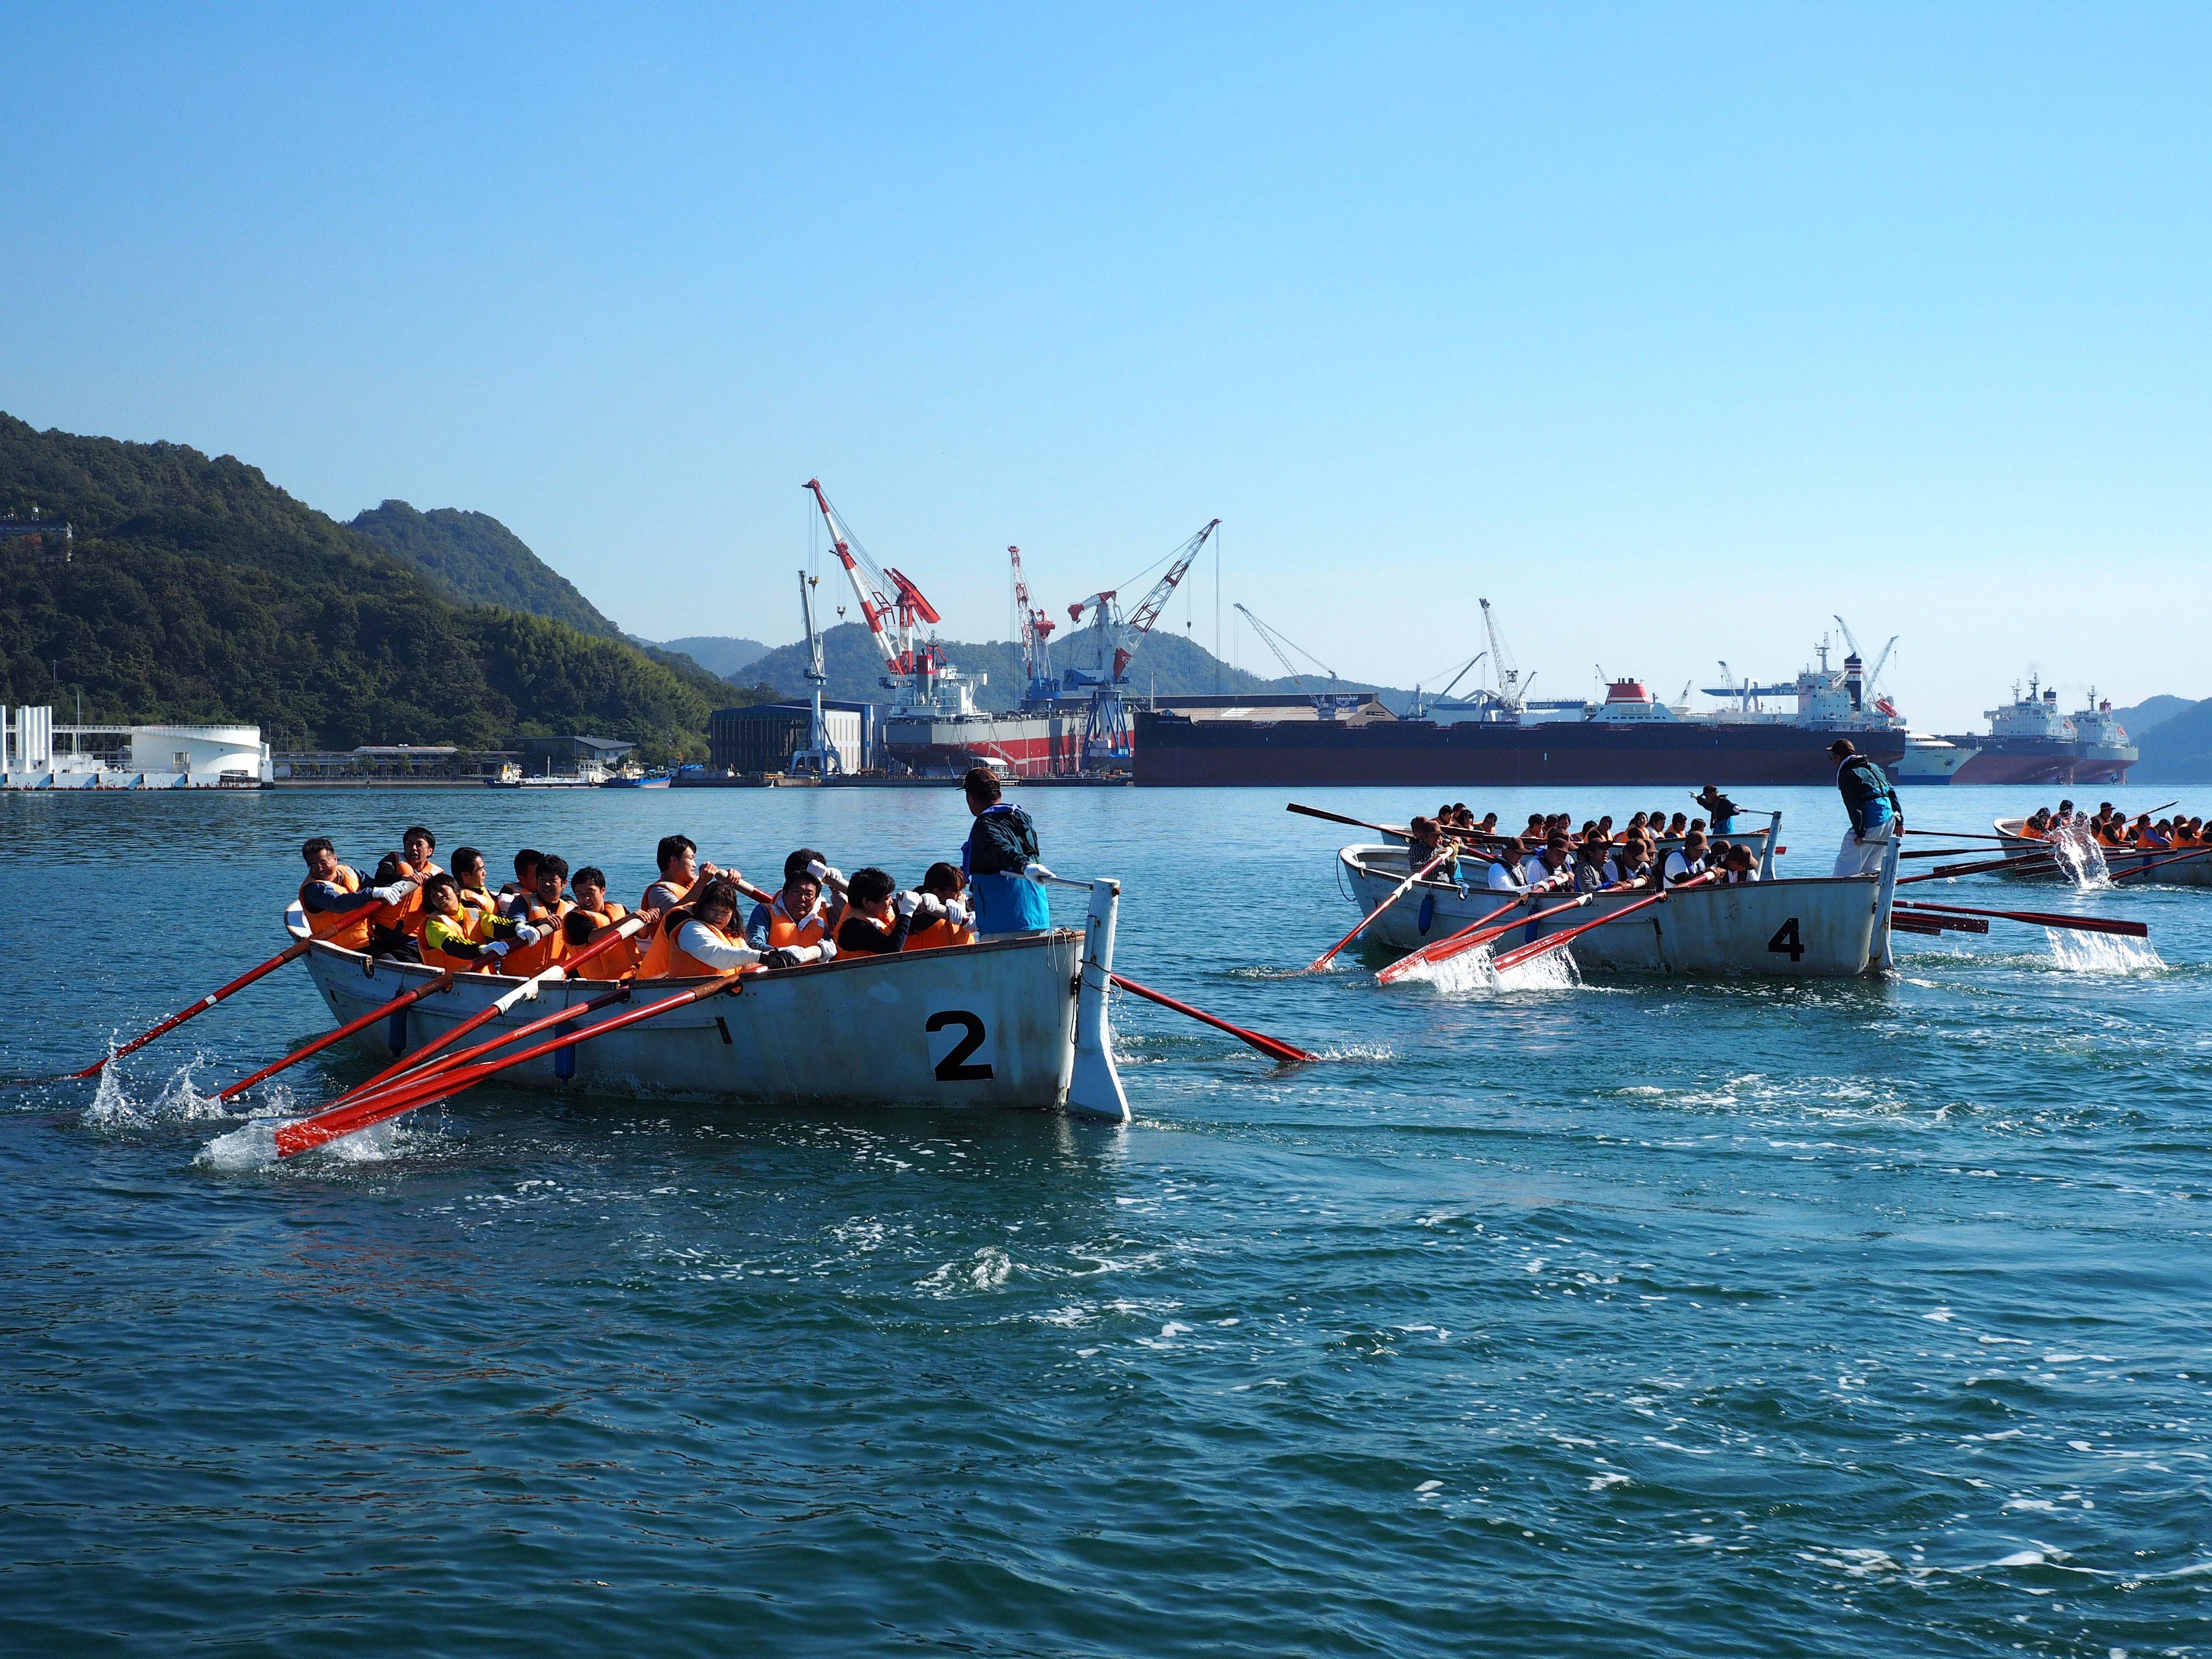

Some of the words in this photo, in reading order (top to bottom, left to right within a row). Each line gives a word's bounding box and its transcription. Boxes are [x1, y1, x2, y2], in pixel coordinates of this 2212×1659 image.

[927, 659, 933, 672] K
[2105, 705, 2111, 714] K
[1767, 917, 1805, 962] 4
[925, 1010, 994, 1082] 2
